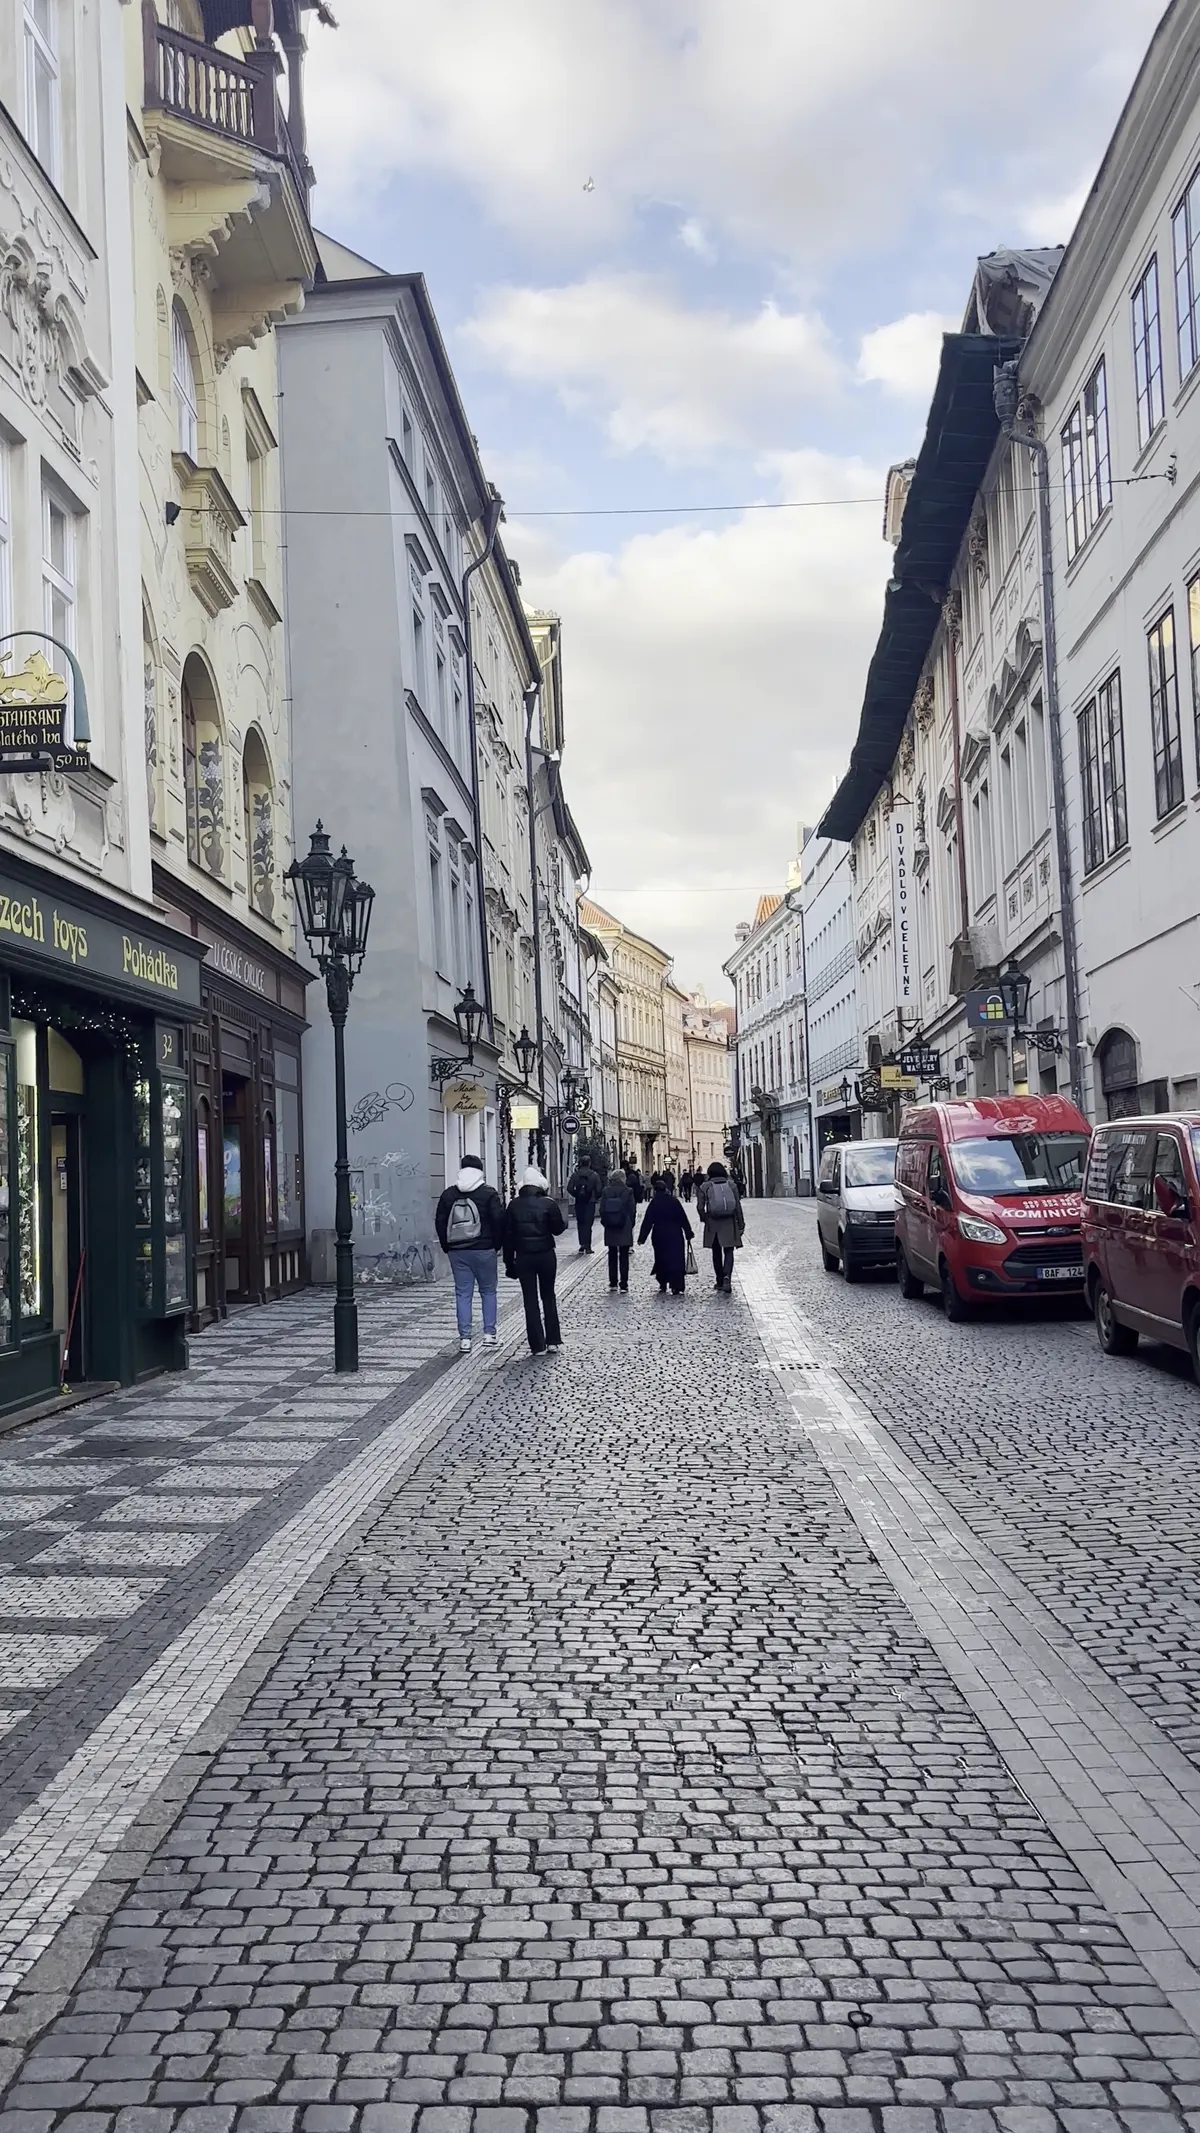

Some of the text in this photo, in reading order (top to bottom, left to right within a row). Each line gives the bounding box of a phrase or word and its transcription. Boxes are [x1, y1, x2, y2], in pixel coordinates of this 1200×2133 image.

[42, 728, 61, 745] lva
[55, 754, 88, 769] 50 m
[896, 823, 907, 900] DIVADLO
[53, 909, 88, 964] toys
[122, 936, 178, 990] Pohádka
[214, 942, 220, 967] U
[244, 961, 265, 992] ORLICE
[900, 920, 910, 996] CELETNÉ
[162, 1034, 173, 1059] 32
[906, 1063, 935, 1072] WAES
[1002, 1205, 1082, 1219] KOMINIC
[1044, 1268, 1060, 1278] 8AF
